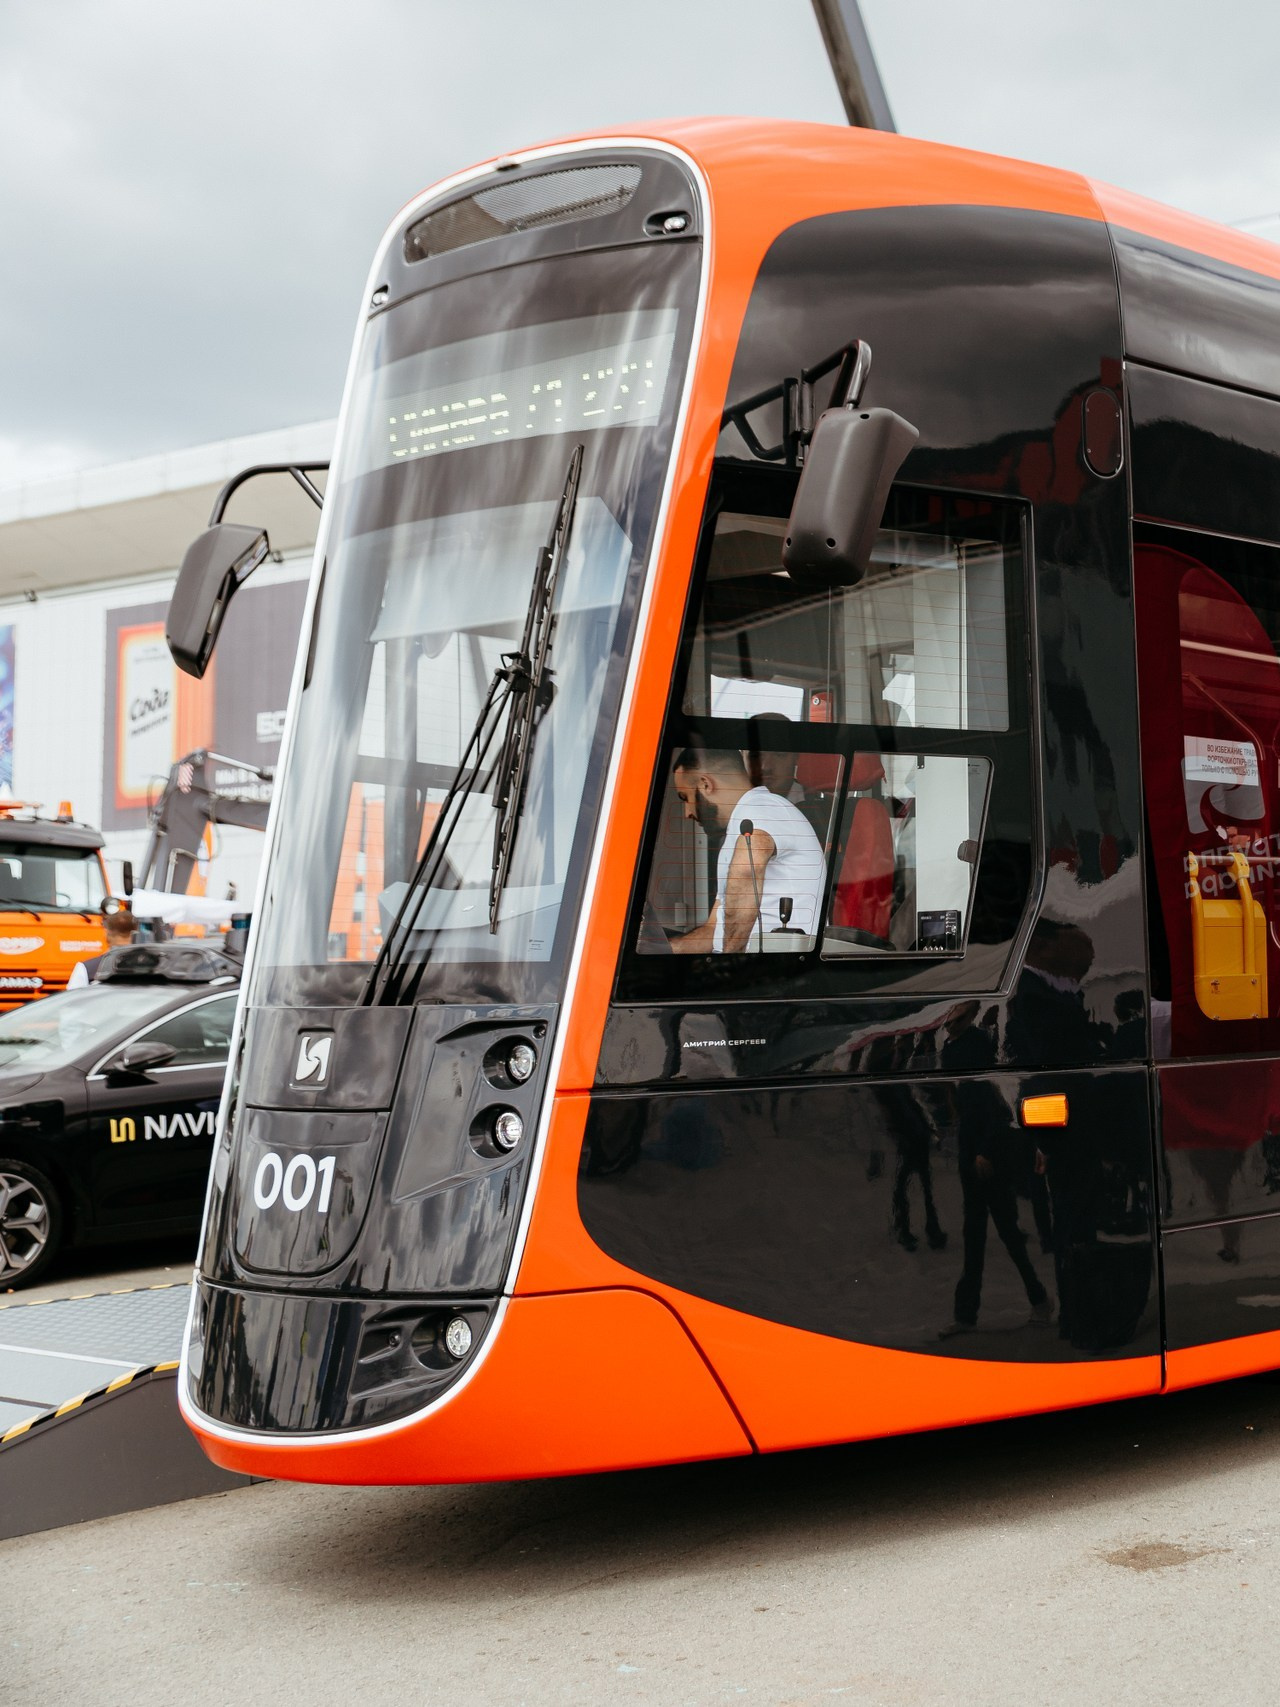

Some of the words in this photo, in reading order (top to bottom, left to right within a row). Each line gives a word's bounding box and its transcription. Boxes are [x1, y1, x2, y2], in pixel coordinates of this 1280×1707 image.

[682, 1039, 727, 1048] ДМИТРИЙ
[728, 1038, 767, 1046] СЕРГЕЕВ
[143, 1110, 219, 1141] NAVI
[252, 1152, 337, 1213] 001
